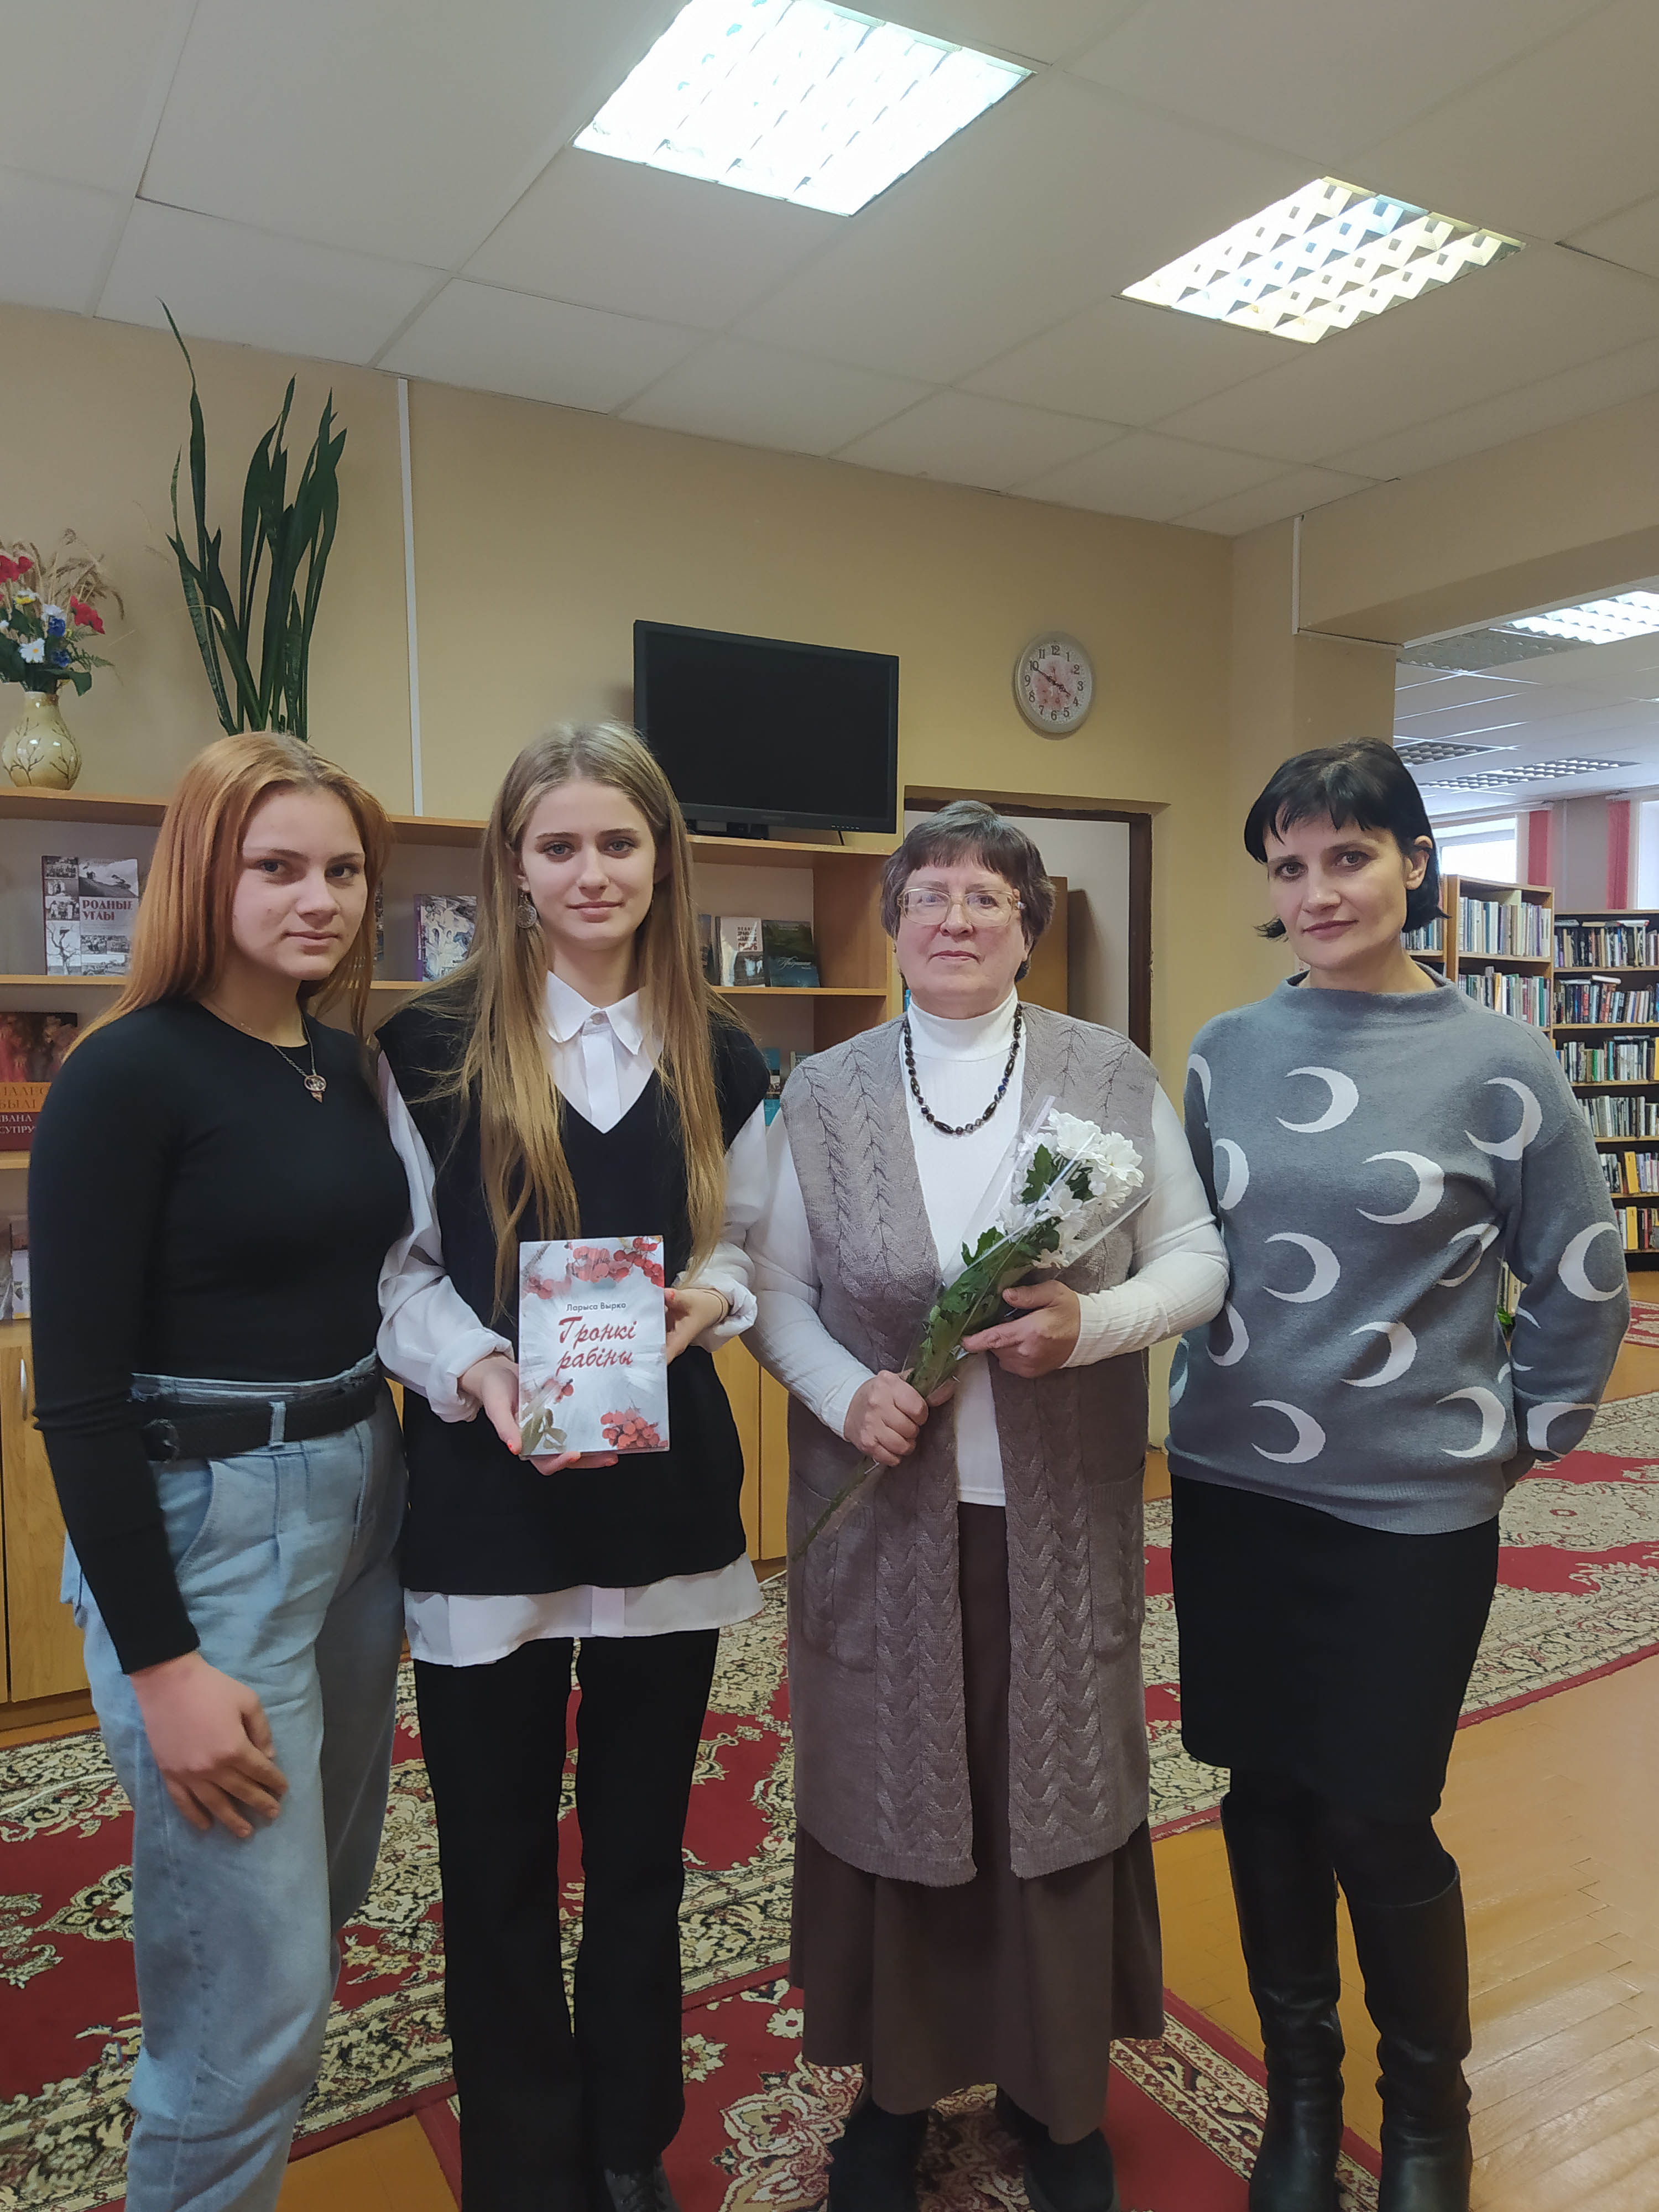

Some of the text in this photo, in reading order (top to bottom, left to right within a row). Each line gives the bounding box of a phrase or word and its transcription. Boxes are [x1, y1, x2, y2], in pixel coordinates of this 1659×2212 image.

[1039, 649, 1045, 659] 11
[1051, 645, 1061, 656] 12
[1066, 653, 1070, 662] 1
[1029, 660, 1039, 671] 10
[1074, 664, 1080, 675] 2
[1025, 675, 1031, 686] 9
[1077, 681, 1084, 691] 3
[1029, 690, 1035, 702] 8
[1073, 696, 1078, 706] 4
[1039, 705, 1044, 715] 7
[1051, 710, 1057, 721] 6
[1063, 707, 1070, 717] 5
[82, 900, 133, 910] РОДНЫЕ
[82, 911, 114, 921] УГЛЫ
[566, 1302, 627, 1313] Ларыса Вырко
[559, 1316, 638, 1350] Гронкі
[555, 1347, 633, 1377] рабіны
